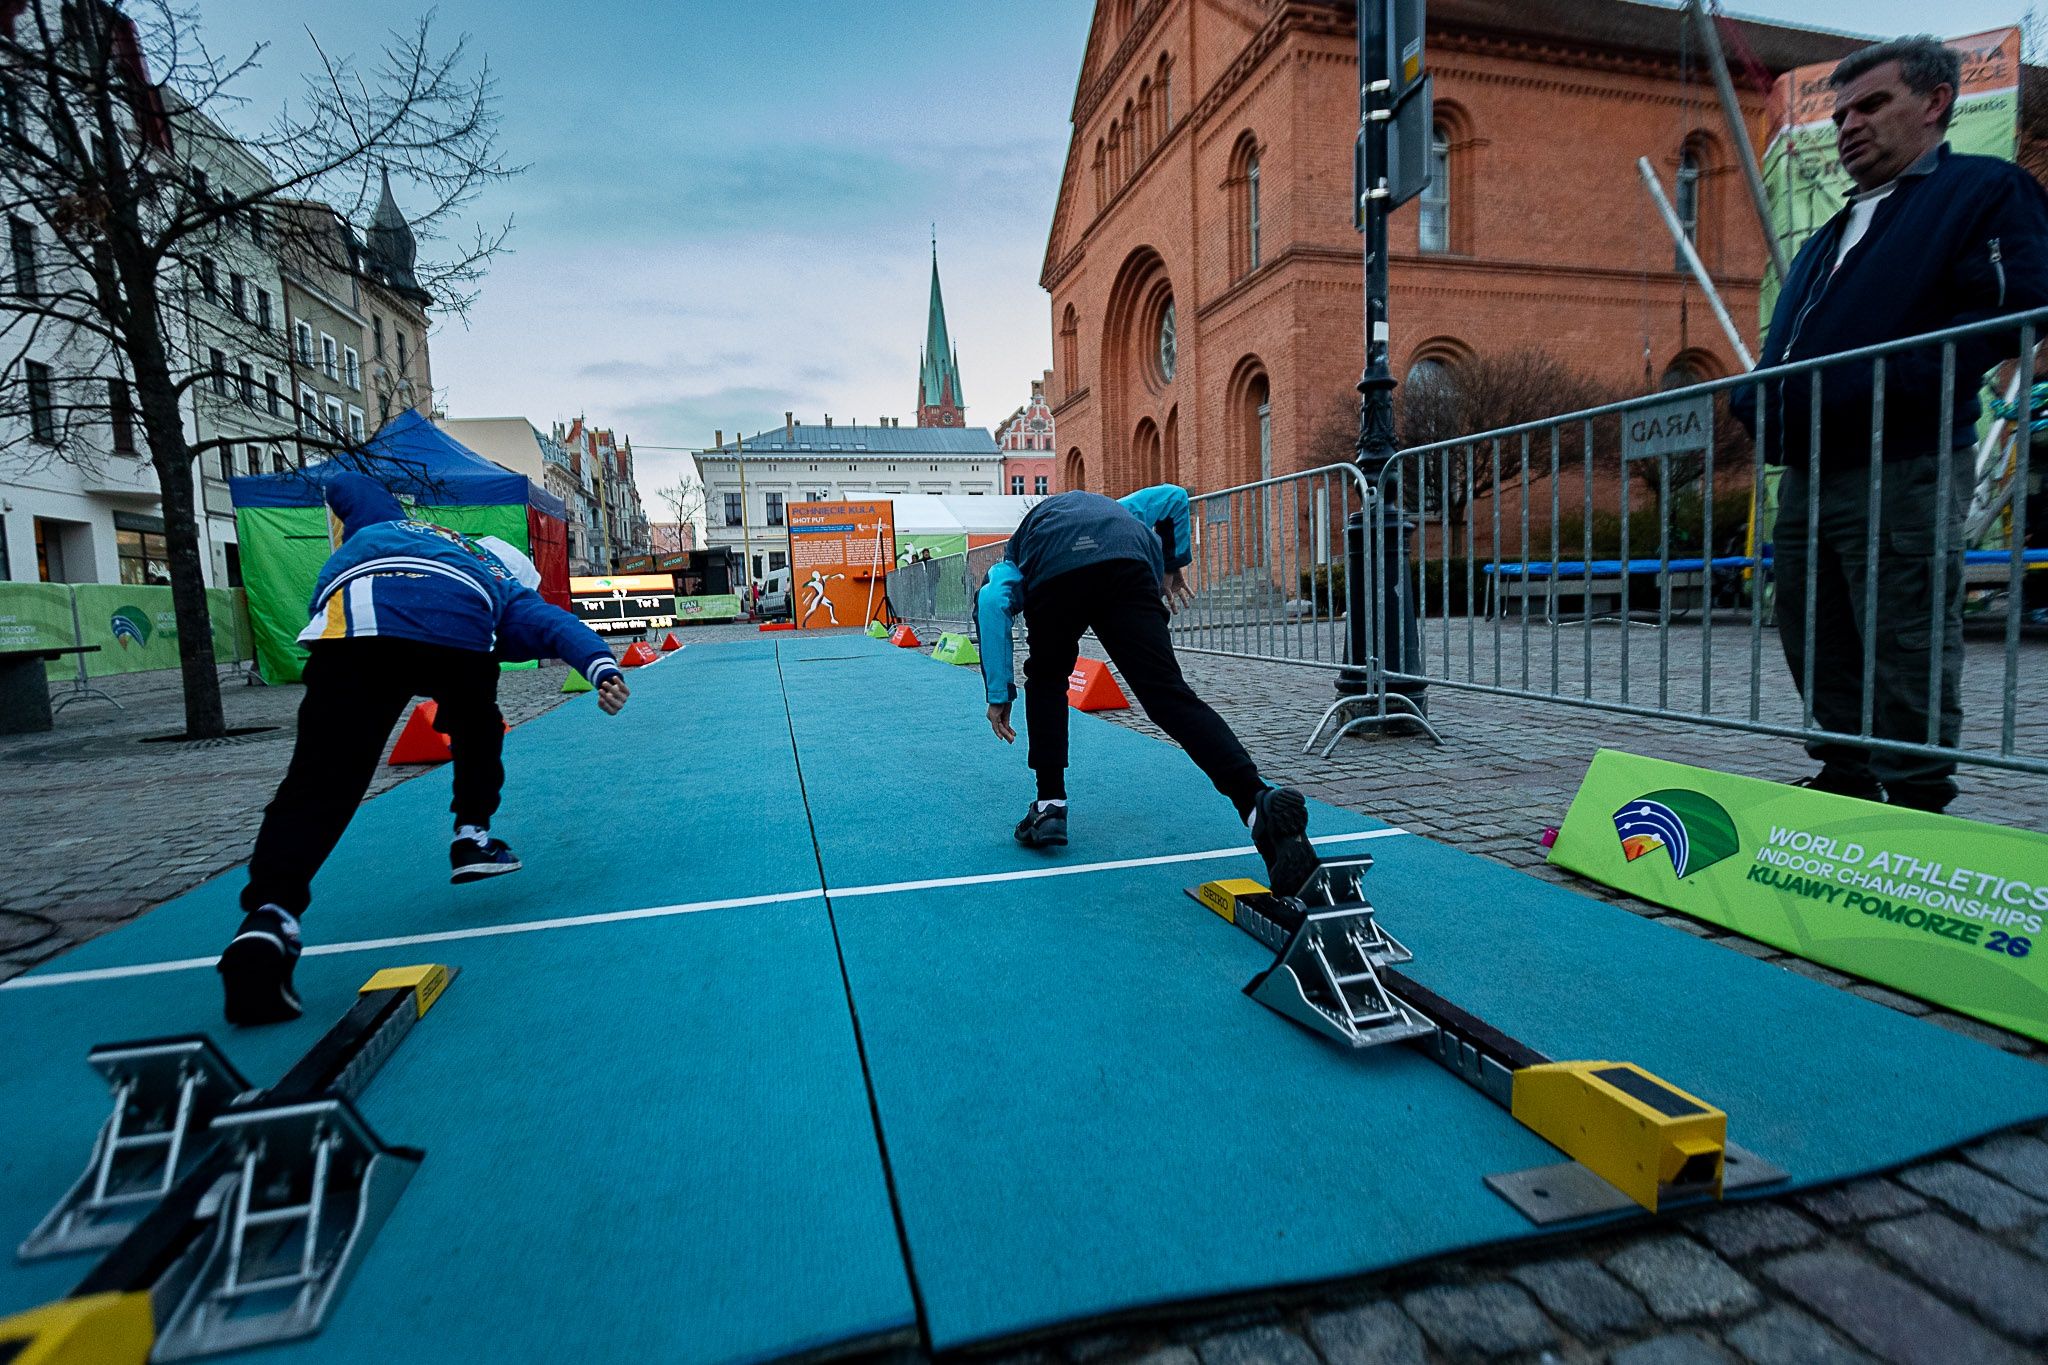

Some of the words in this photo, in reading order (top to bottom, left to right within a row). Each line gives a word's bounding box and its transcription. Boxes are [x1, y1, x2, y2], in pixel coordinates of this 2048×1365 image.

[811, 516, 825, 524] PUT
[681, 600, 697, 609] FAN
[1756, 846, 1834, 878] INDOOR
[1837, 867, 2044, 935] CHAMPIONSHIPS
[1768, 825, 1865, 865] WORLD
[1867, 851, 2048, 912] ATHLETICS
[1203, 885, 1229, 911] SEIKO
[1746, 864, 1845, 905] KUJAWY
[1843, 891, 1985, 946] POMORZE
[1984, 930, 2034, 959] 26
